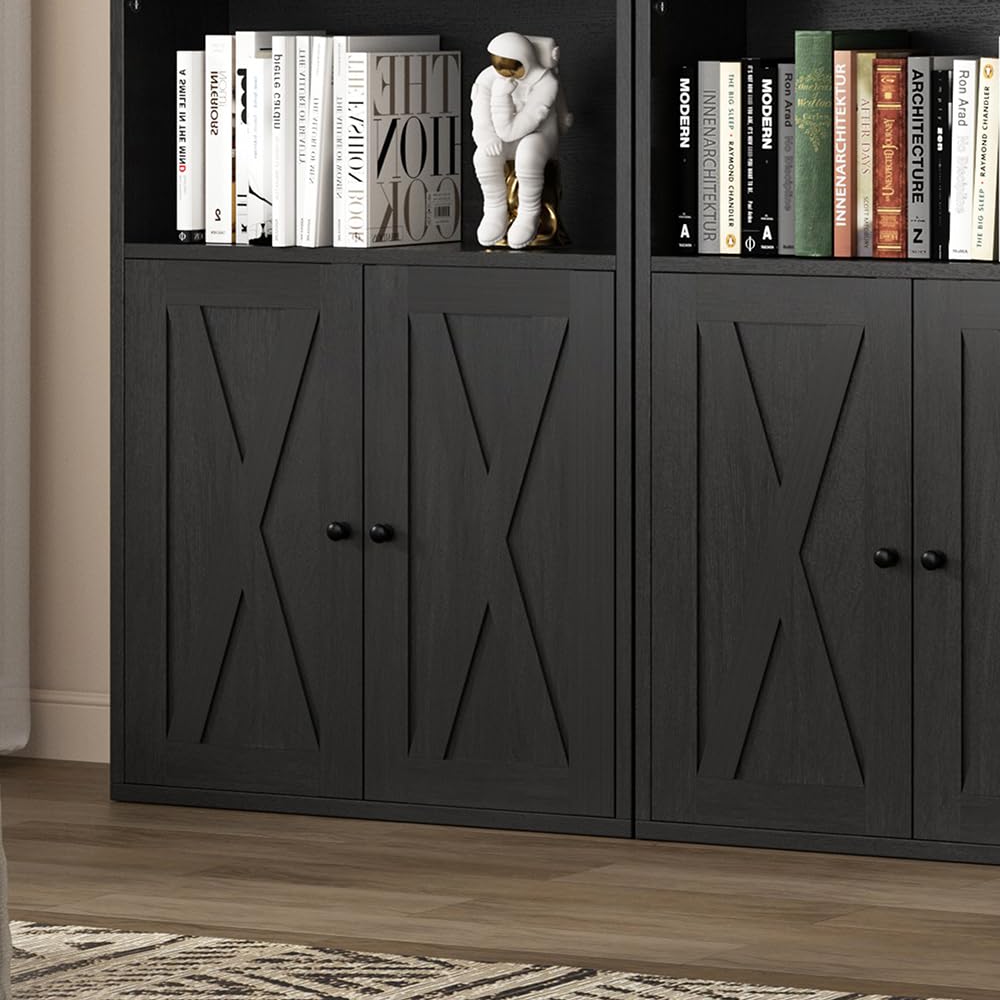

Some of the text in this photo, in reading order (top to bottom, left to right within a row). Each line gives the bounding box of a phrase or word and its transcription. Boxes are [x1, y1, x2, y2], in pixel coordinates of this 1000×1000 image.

[680, 78, 690, 148] MODERN
[762, 79, 772, 149] MODERN
[958, 70, 970, 127] Ron Arad
[982, 86, 990, 131] CHANDLER
[703, 90, 717, 241] INNENARCHITEKTUR
[835, 64, 847, 226] INNENARCHITEKTUR
[862, 98, 871, 176] AFTER DAYS
[912, 69, 924, 203] ARCHITECTURE
[980, 133, 988, 177] RAYMOND
[680, 224, 690, 238] A
[763, 225, 772, 240] A
[913, 228, 923, 243] Z
